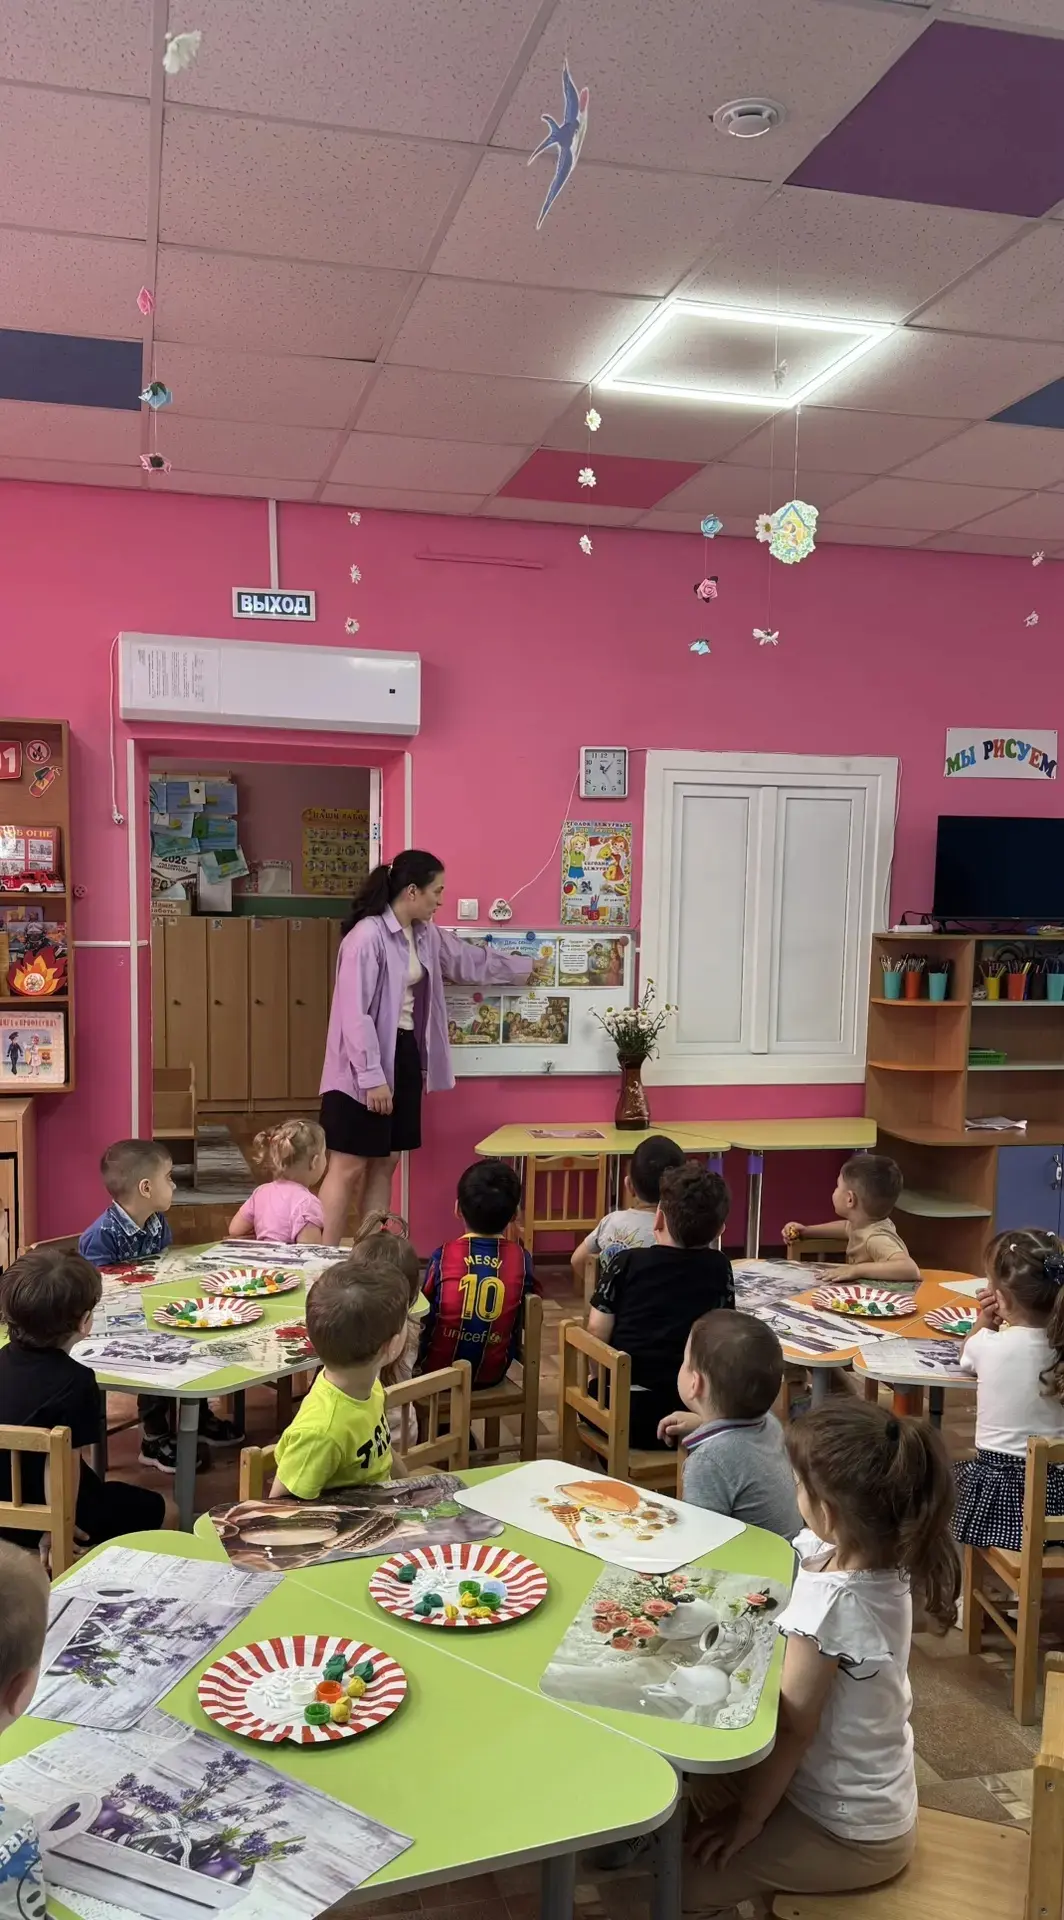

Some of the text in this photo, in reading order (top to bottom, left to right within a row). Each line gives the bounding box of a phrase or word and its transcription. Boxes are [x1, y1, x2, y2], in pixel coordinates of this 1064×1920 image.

[241, 595, 308, 614] ВЫХОД
[945, 738, 1058, 779] МЫ РИСУЕМ
[341, 813, 369, 821] РАБОТ
[26, 830, 53, 838] ОГНЕ
[161, 855, 188, 866] 2026
[464, 1255, 503, 1269] MESSI
[458, 1274, 505, 1322] 10
[443, 1328, 488, 1343] unicef
[0, 1820, 38, 1870] STRE
